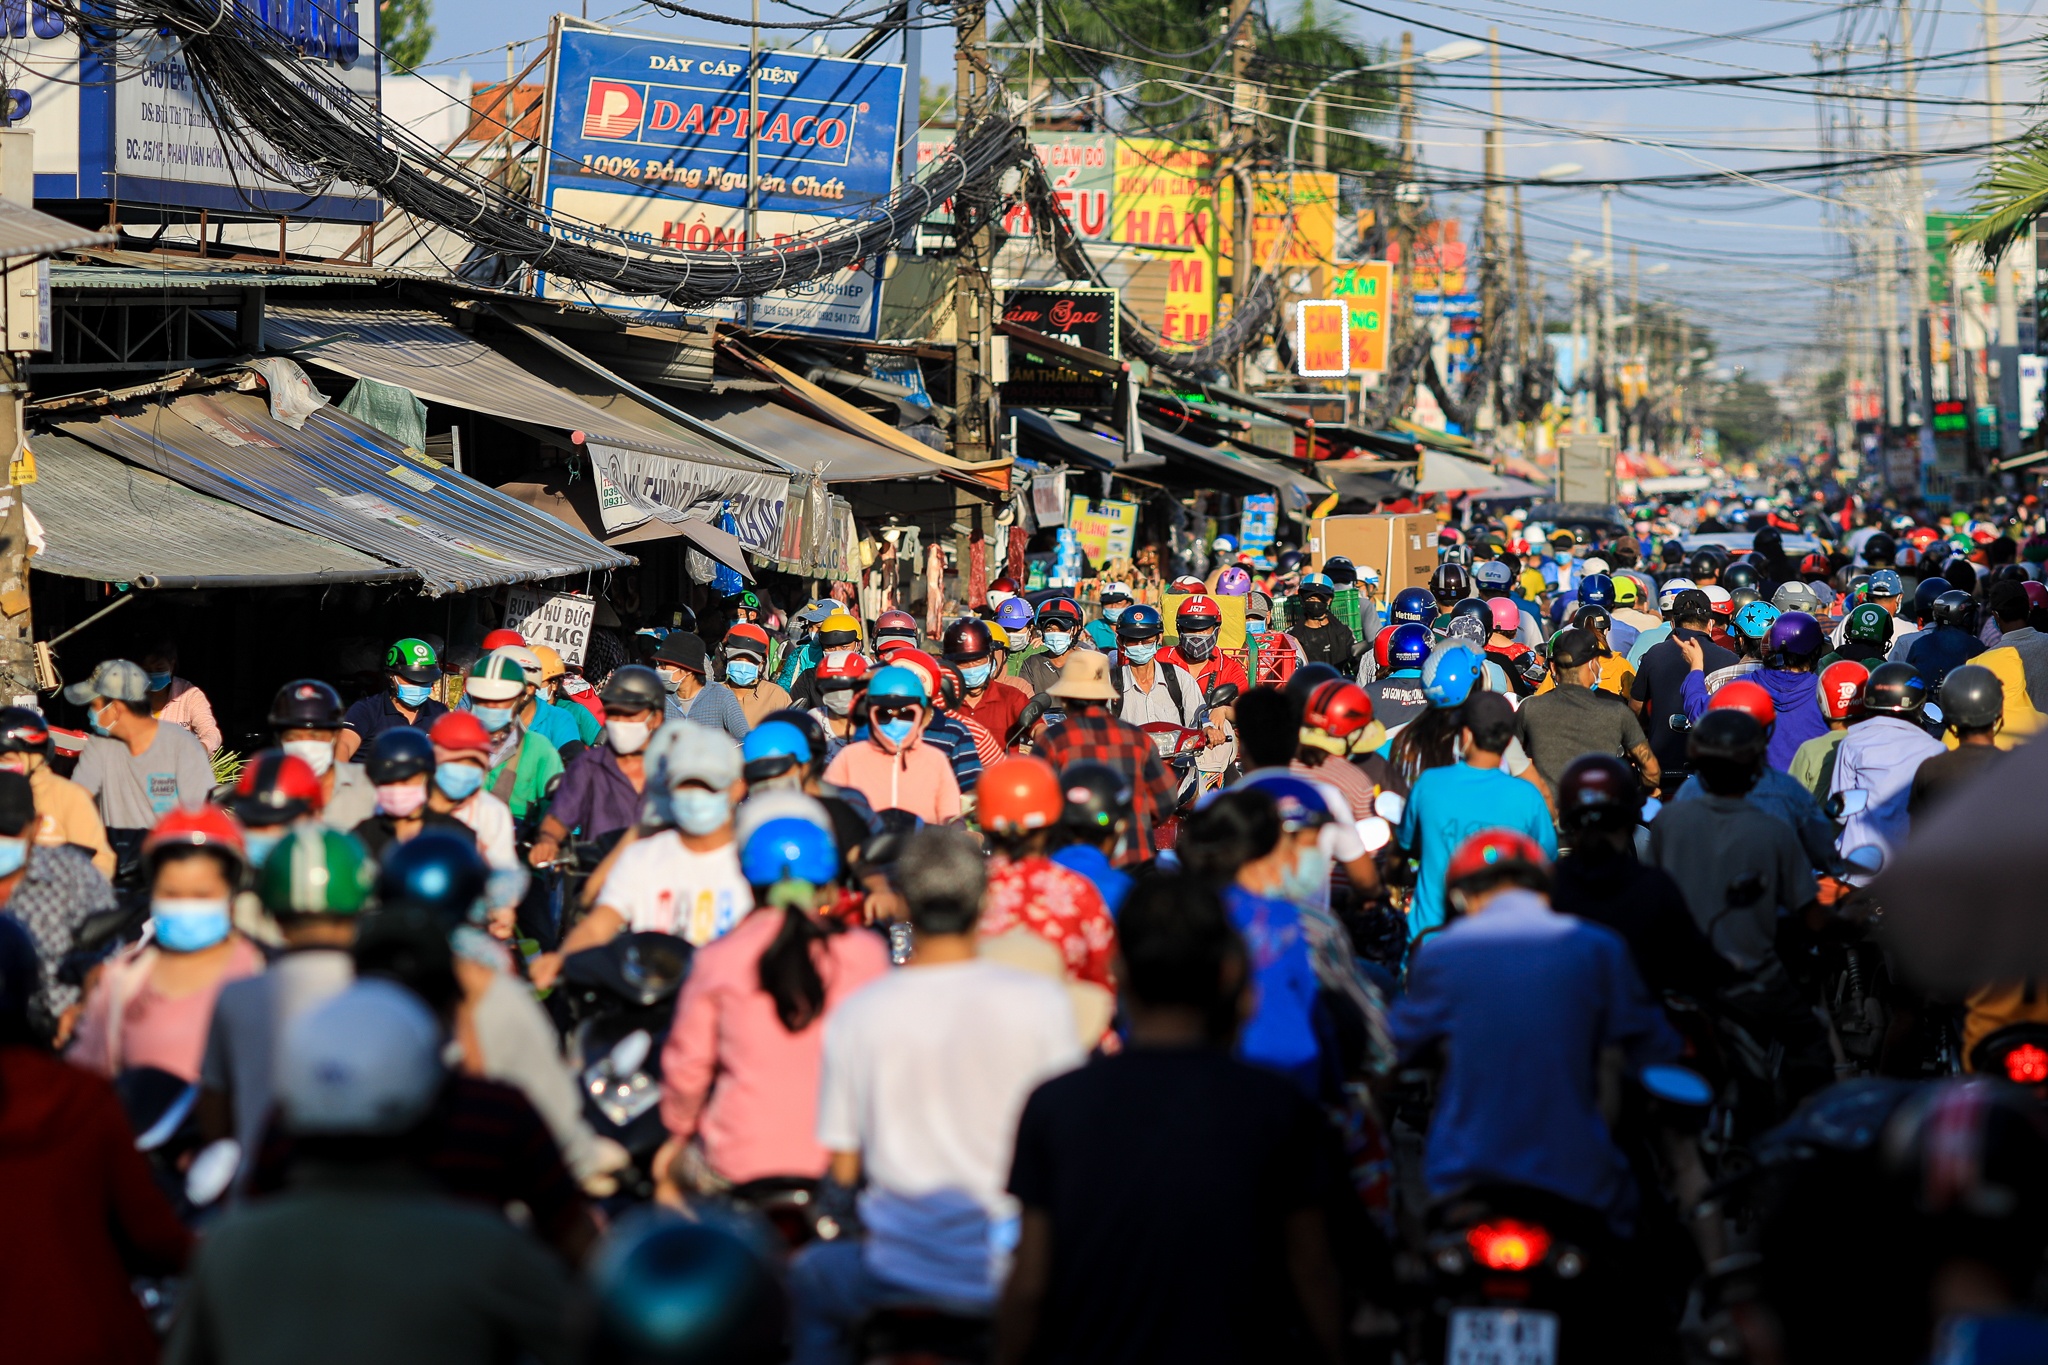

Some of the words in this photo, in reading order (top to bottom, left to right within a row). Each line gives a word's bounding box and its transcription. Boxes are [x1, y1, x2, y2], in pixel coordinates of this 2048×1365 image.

[649, 55, 693, 73] DÂY
[699, 59, 741, 77] CÁP
[648, 100, 847, 148] DAPHACO
[126, 138, 141, 160] ĐC:
[190, 140, 204, 167] VĂN
[580, 154, 640, 178] 100%
[643, 159, 702, 188] Đồng
[791, 175, 845, 199] Chất
[1127, 205, 1207, 245] HÂN
[1049, 299, 1102, 332] Spa
[508, 594, 534, 617] BÚN
[537, 600, 562, 623] THỦ
[564, 605, 591, 629] ĐỨC
[1187, 605, 1207, 613] J&T
[543, 624, 584, 648] 1KG
